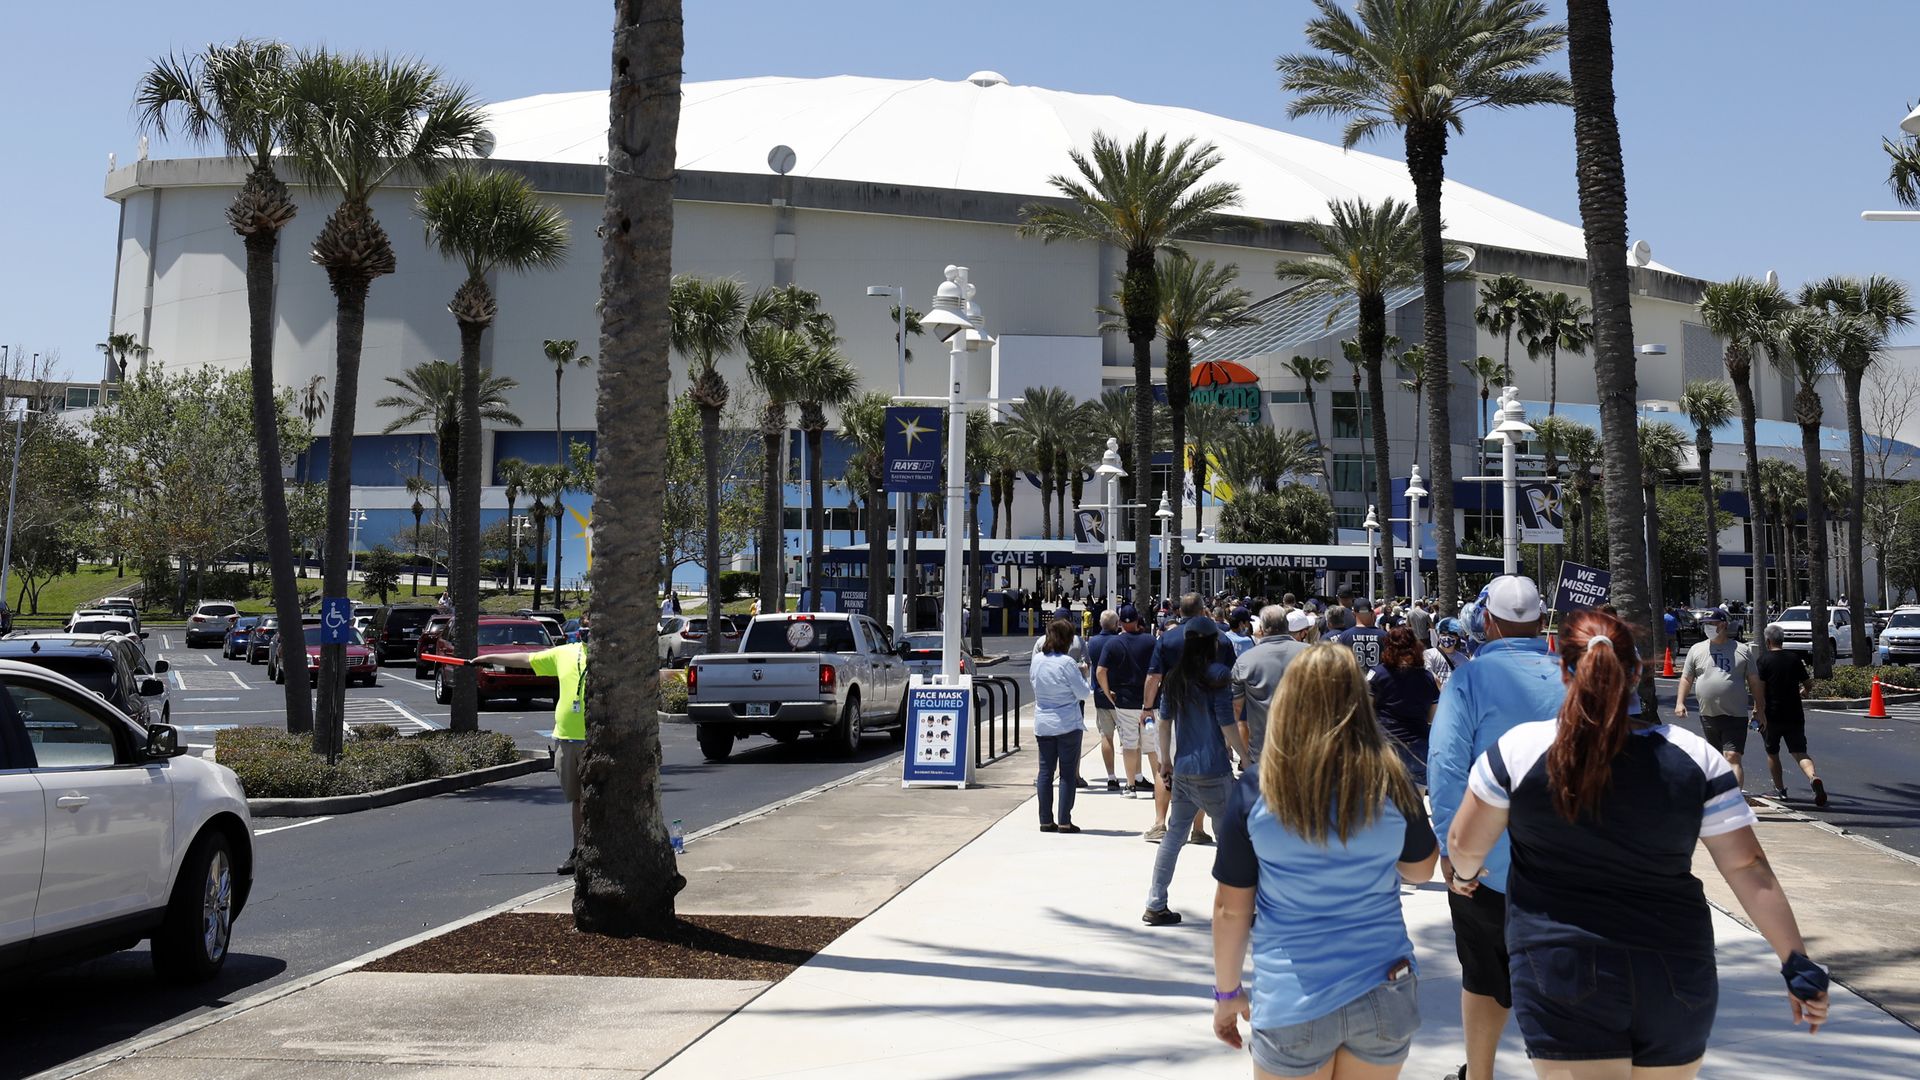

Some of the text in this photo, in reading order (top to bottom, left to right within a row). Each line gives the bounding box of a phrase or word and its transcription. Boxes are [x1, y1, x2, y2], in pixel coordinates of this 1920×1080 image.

[991, 551, 1048, 564] GATE 1
[1217, 555, 1290, 567] TROPICANA
[1293, 556, 1328, 567] FIELD
[1577, 569, 1597, 582] WE
[1561, 578, 1606, 597] MISSED
[841, 591, 868, 599] ACCESSIBLE
[1569, 592, 1596, 607] YOU!
[844, 600, 864, 608] PARKING
[1353, 642, 1380, 667] 63
[913, 700, 964, 708] REQUIRED
